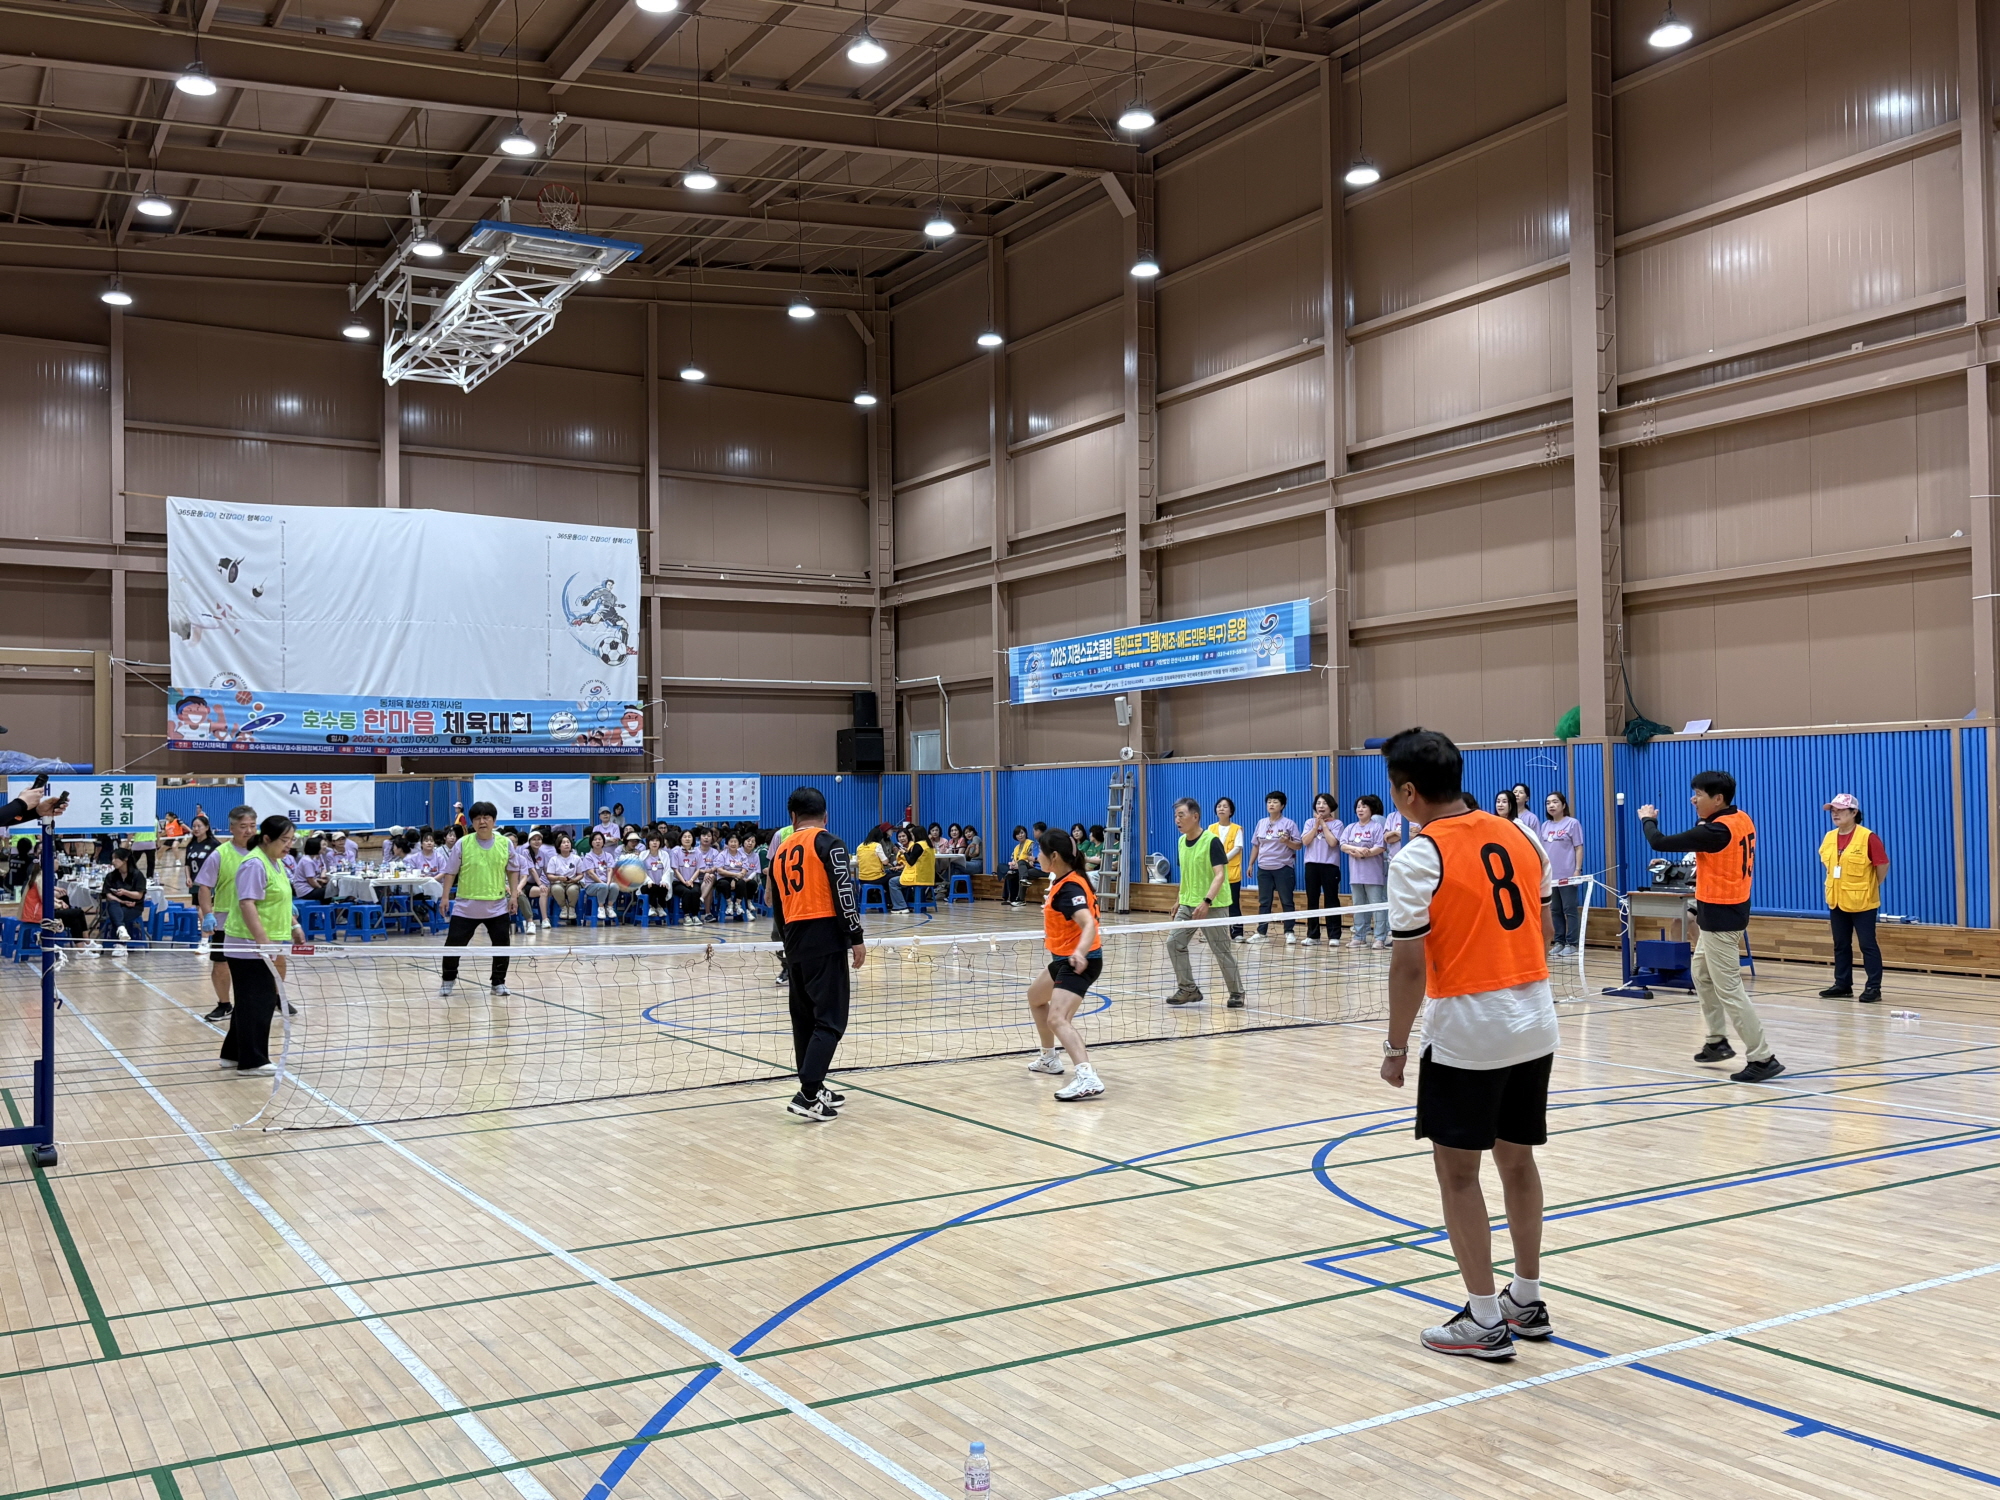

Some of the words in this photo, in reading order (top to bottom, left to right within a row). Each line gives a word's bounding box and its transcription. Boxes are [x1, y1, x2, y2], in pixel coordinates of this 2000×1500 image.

[1051, 645, 1067, 668] 2025
[1067, 637, 1113, 666] 지정스포츠클럽
[1227, 616, 1247, 643] 운영
[380, 699, 403, 708] 동체육
[406, 699, 430, 709] 활성화
[431, 700, 462, 709] 지원사업
[302, 709, 357, 731] 호수동
[364, 709, 435, 735] 한마음
[442, 710, 532, 735] 체육대회
[192, 741, 227, 750] 안산시체육회
[330, 734, 344, 743] 일시
[352, 735, 375, 743] 2025.
[387, 736, 399, 744] 24.
[455, 736, 467, 744] 장소
[475, 736, 512, 744] 호수체육관
[668, 780, 679, 816] 연합팀
[778, 844, 805, 896] 13
[1480, 842, 1525, 931] 8
